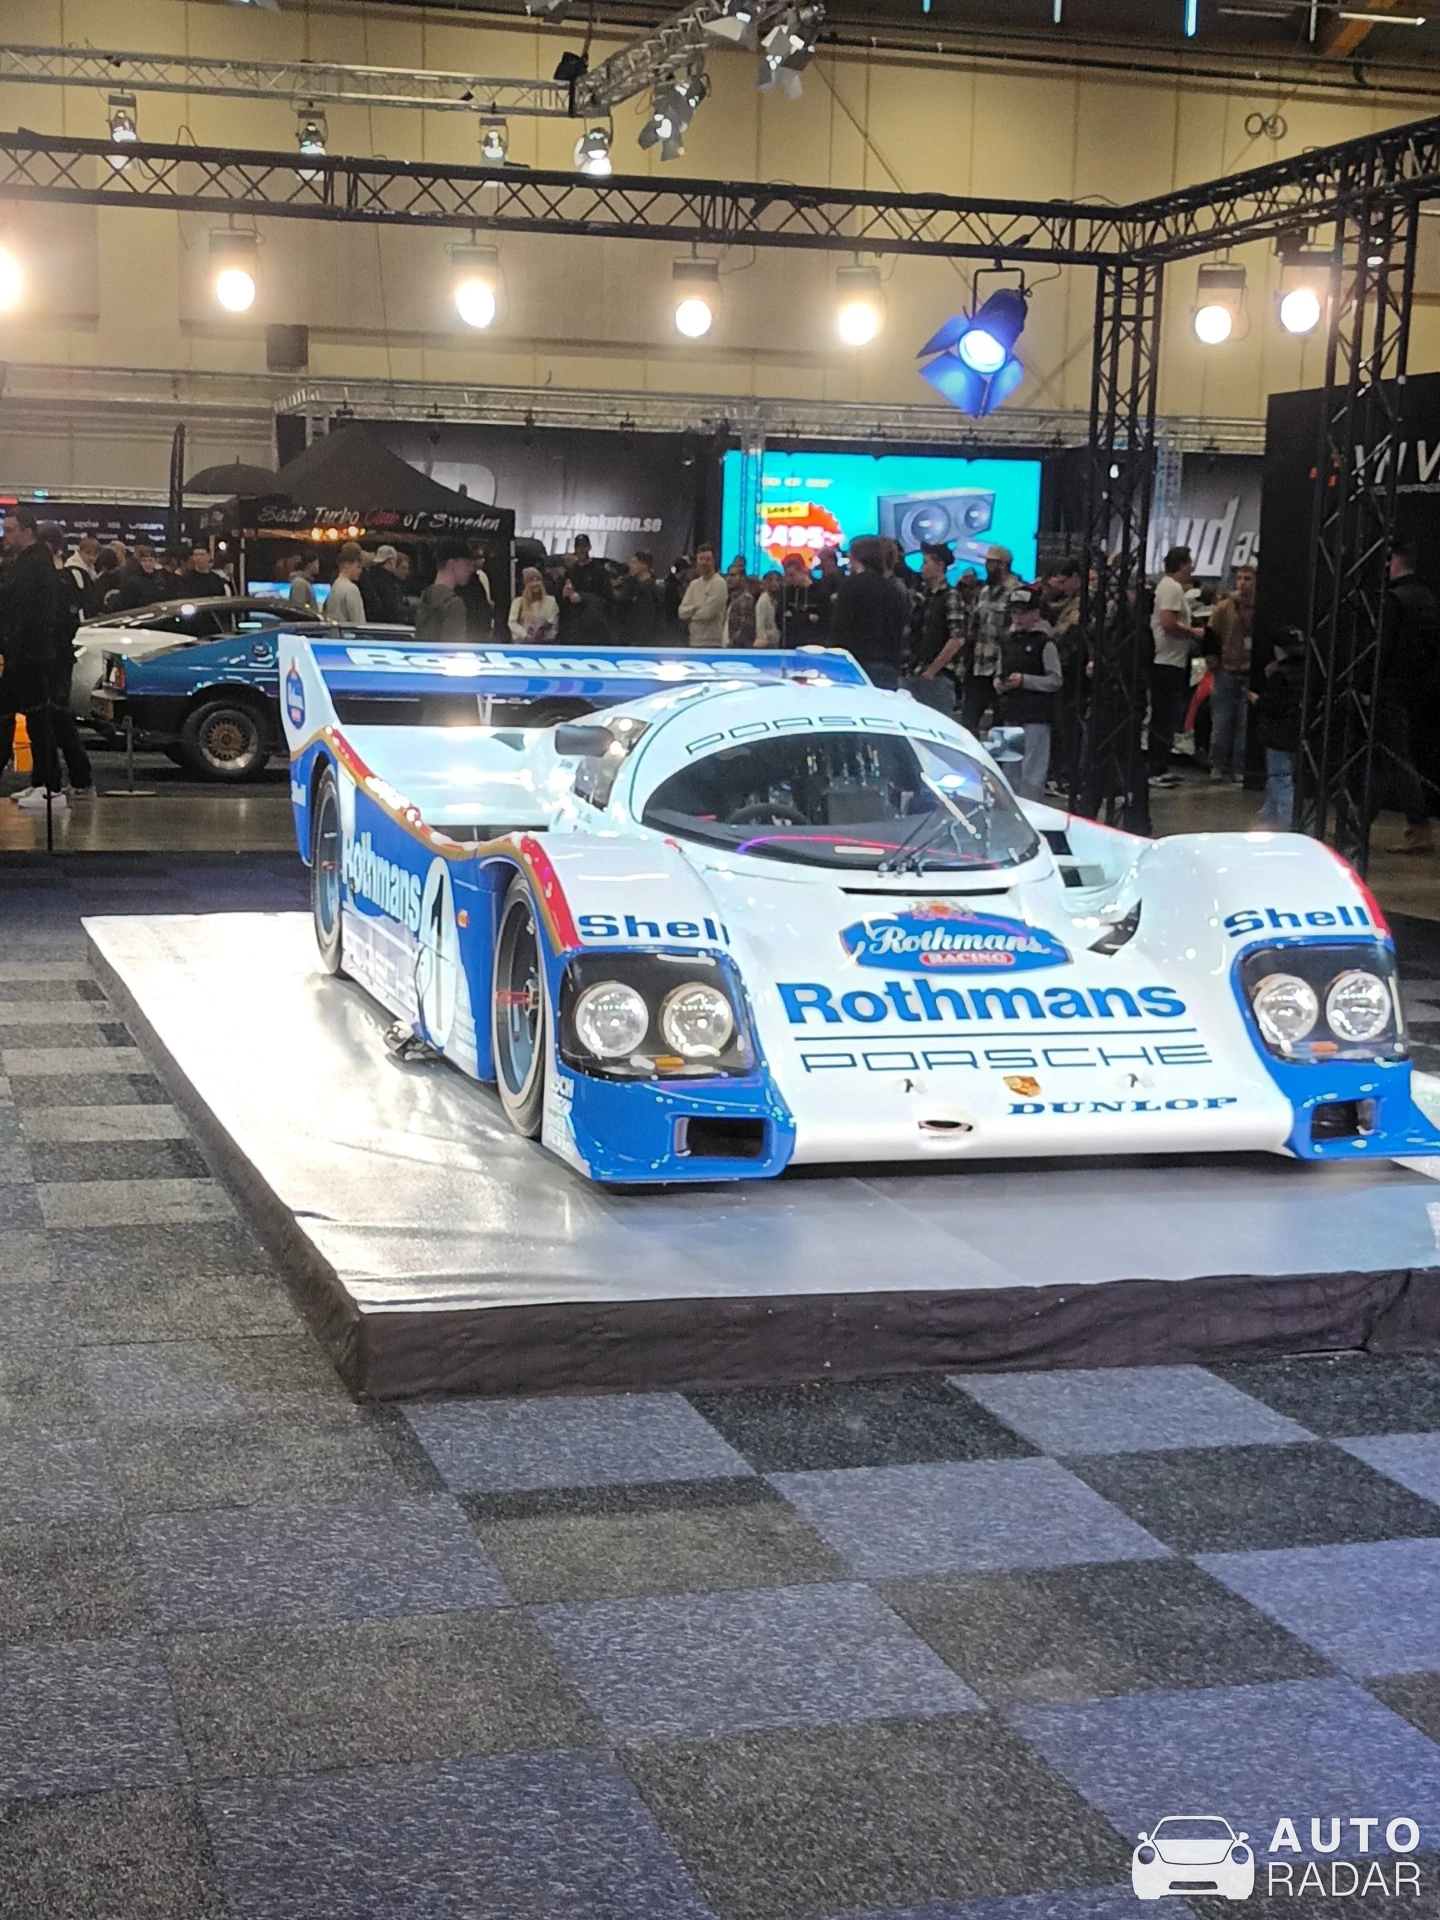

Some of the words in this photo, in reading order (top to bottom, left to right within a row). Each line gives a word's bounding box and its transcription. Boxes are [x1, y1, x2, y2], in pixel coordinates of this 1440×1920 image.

[313, 506, 360, 525] Turbo
[403, 511, 427, 531] of
[429, 513, 501, 532] Sweden
[346, 646, 762, 677] Rothmans
[341, 830, 421, 933] Rothmans
[578, 914, 731, 947] Shell
[1223, 905, 1371, 939] Shell
[869, 925, 1051, 956] Rothmans
[926, 951, 1009, 964] RACING
[775, 978, 1187, 1025] Rothmans
[800, 1043, 1213, 1073] PORSCHE
[1007, 1096, 1238, 1116] DUNLOP
